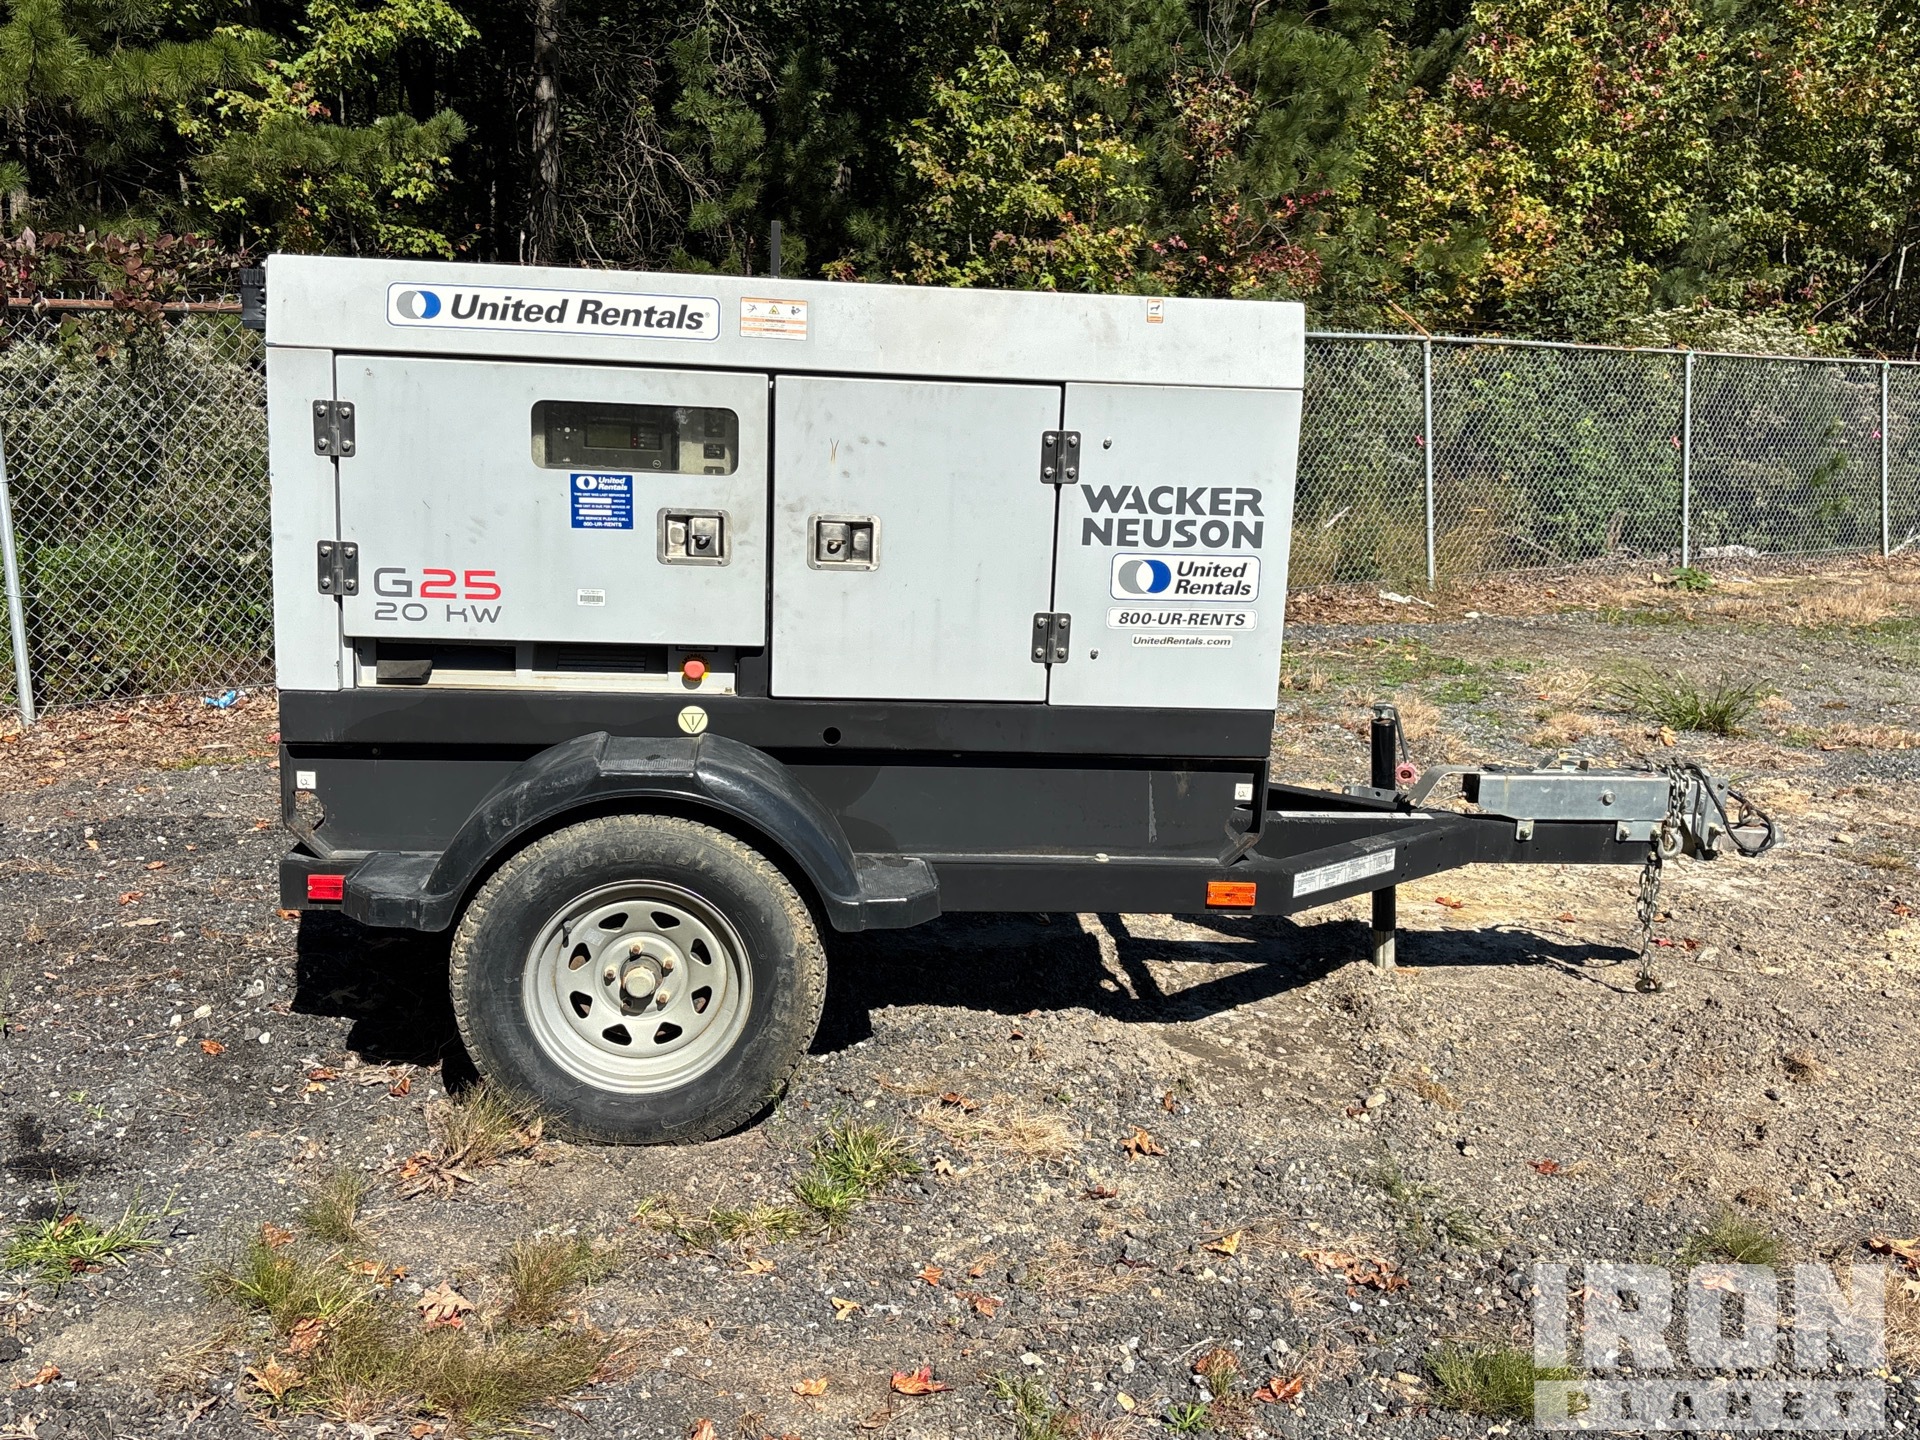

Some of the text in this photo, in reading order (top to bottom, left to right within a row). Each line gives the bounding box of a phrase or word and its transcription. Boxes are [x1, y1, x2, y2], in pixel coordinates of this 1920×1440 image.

[451, 293, 569, 323] United
[598, 476, 626, 484] United
[1081, 484, 1264, 517] WACKER
[1082, 517, 1264, 549] NEUSON
[1176, 561, 1248, 578] United
[373, 567, 501, 600] G25
[1174, 579, 1251, 596] Rentals
[375, 602, 428, 622] 20
[1118, 612, 1246, 626] 800-UR-RENTS
[1132, 636, 1231, 646] UnitedRentals.com
